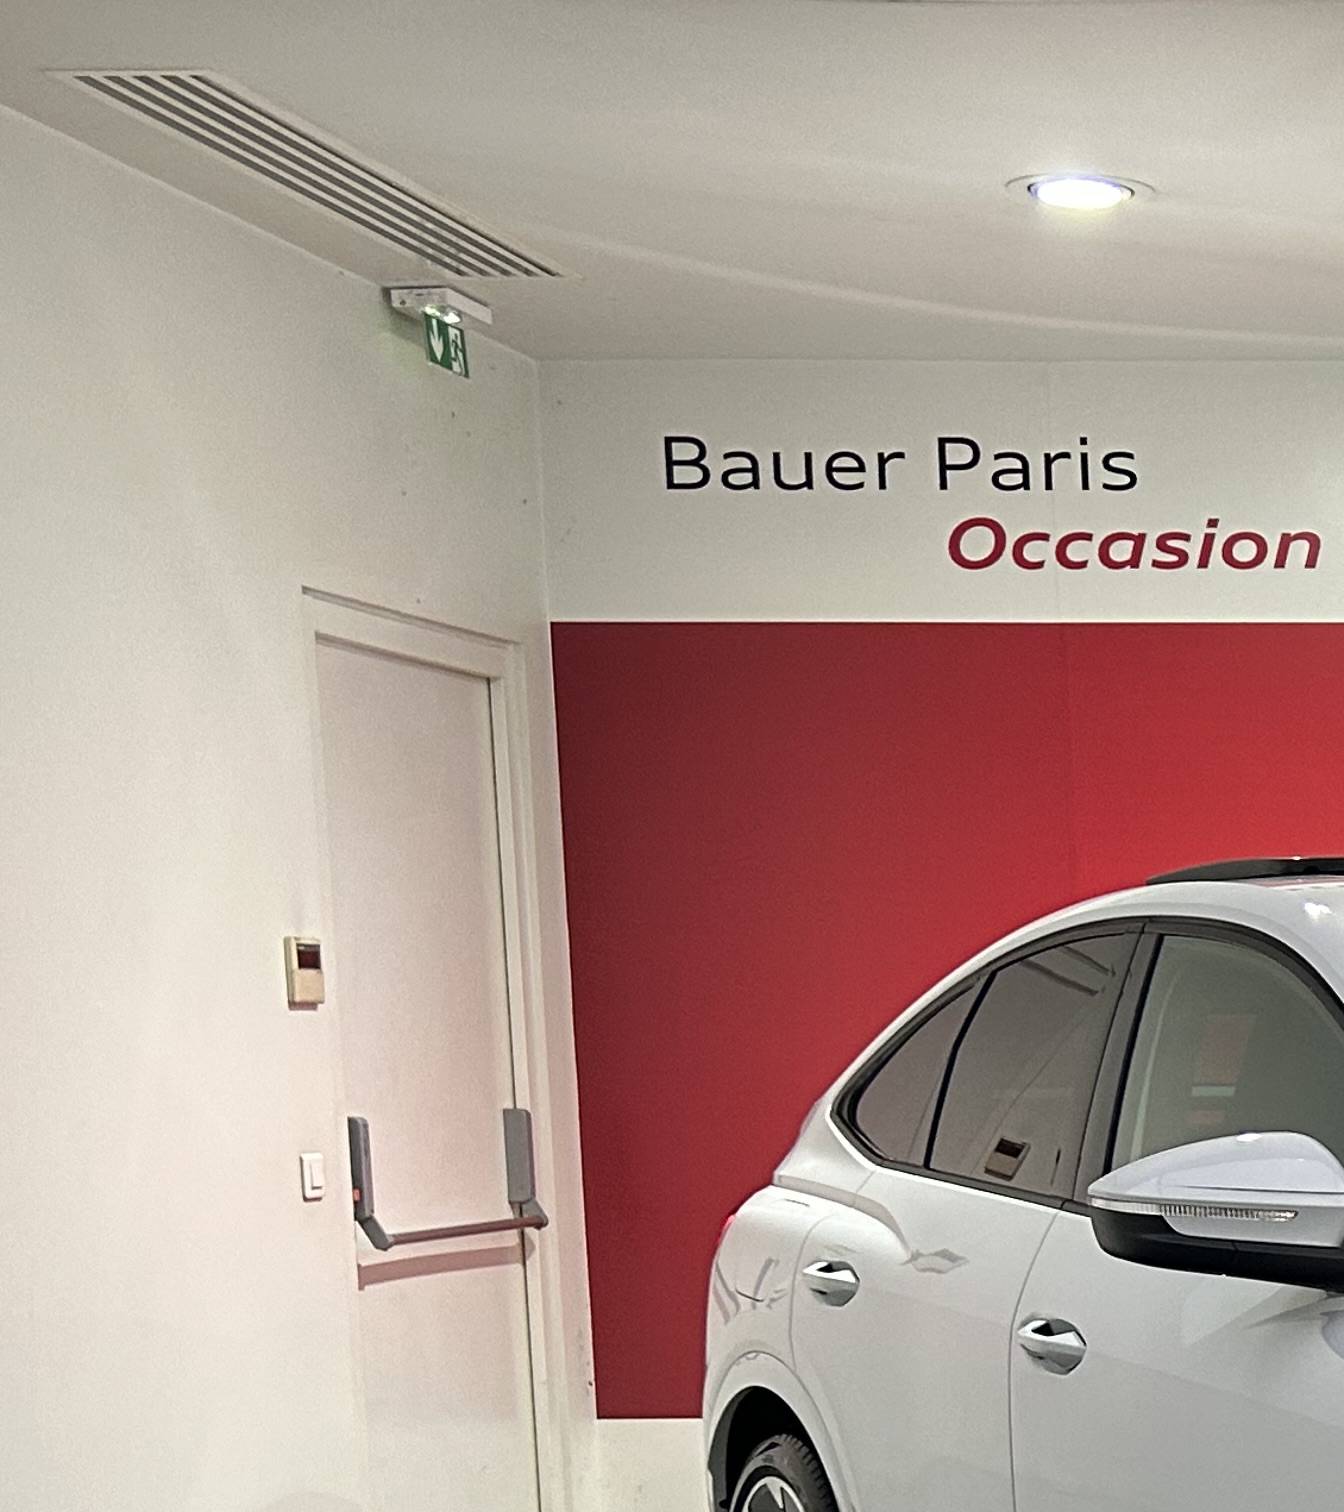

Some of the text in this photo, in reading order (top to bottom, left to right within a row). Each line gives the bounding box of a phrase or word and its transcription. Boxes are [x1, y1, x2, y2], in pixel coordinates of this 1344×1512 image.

[662, 435, 1139, 492] Bauer Paris
[947, 517, 1322, 571] Occasion
